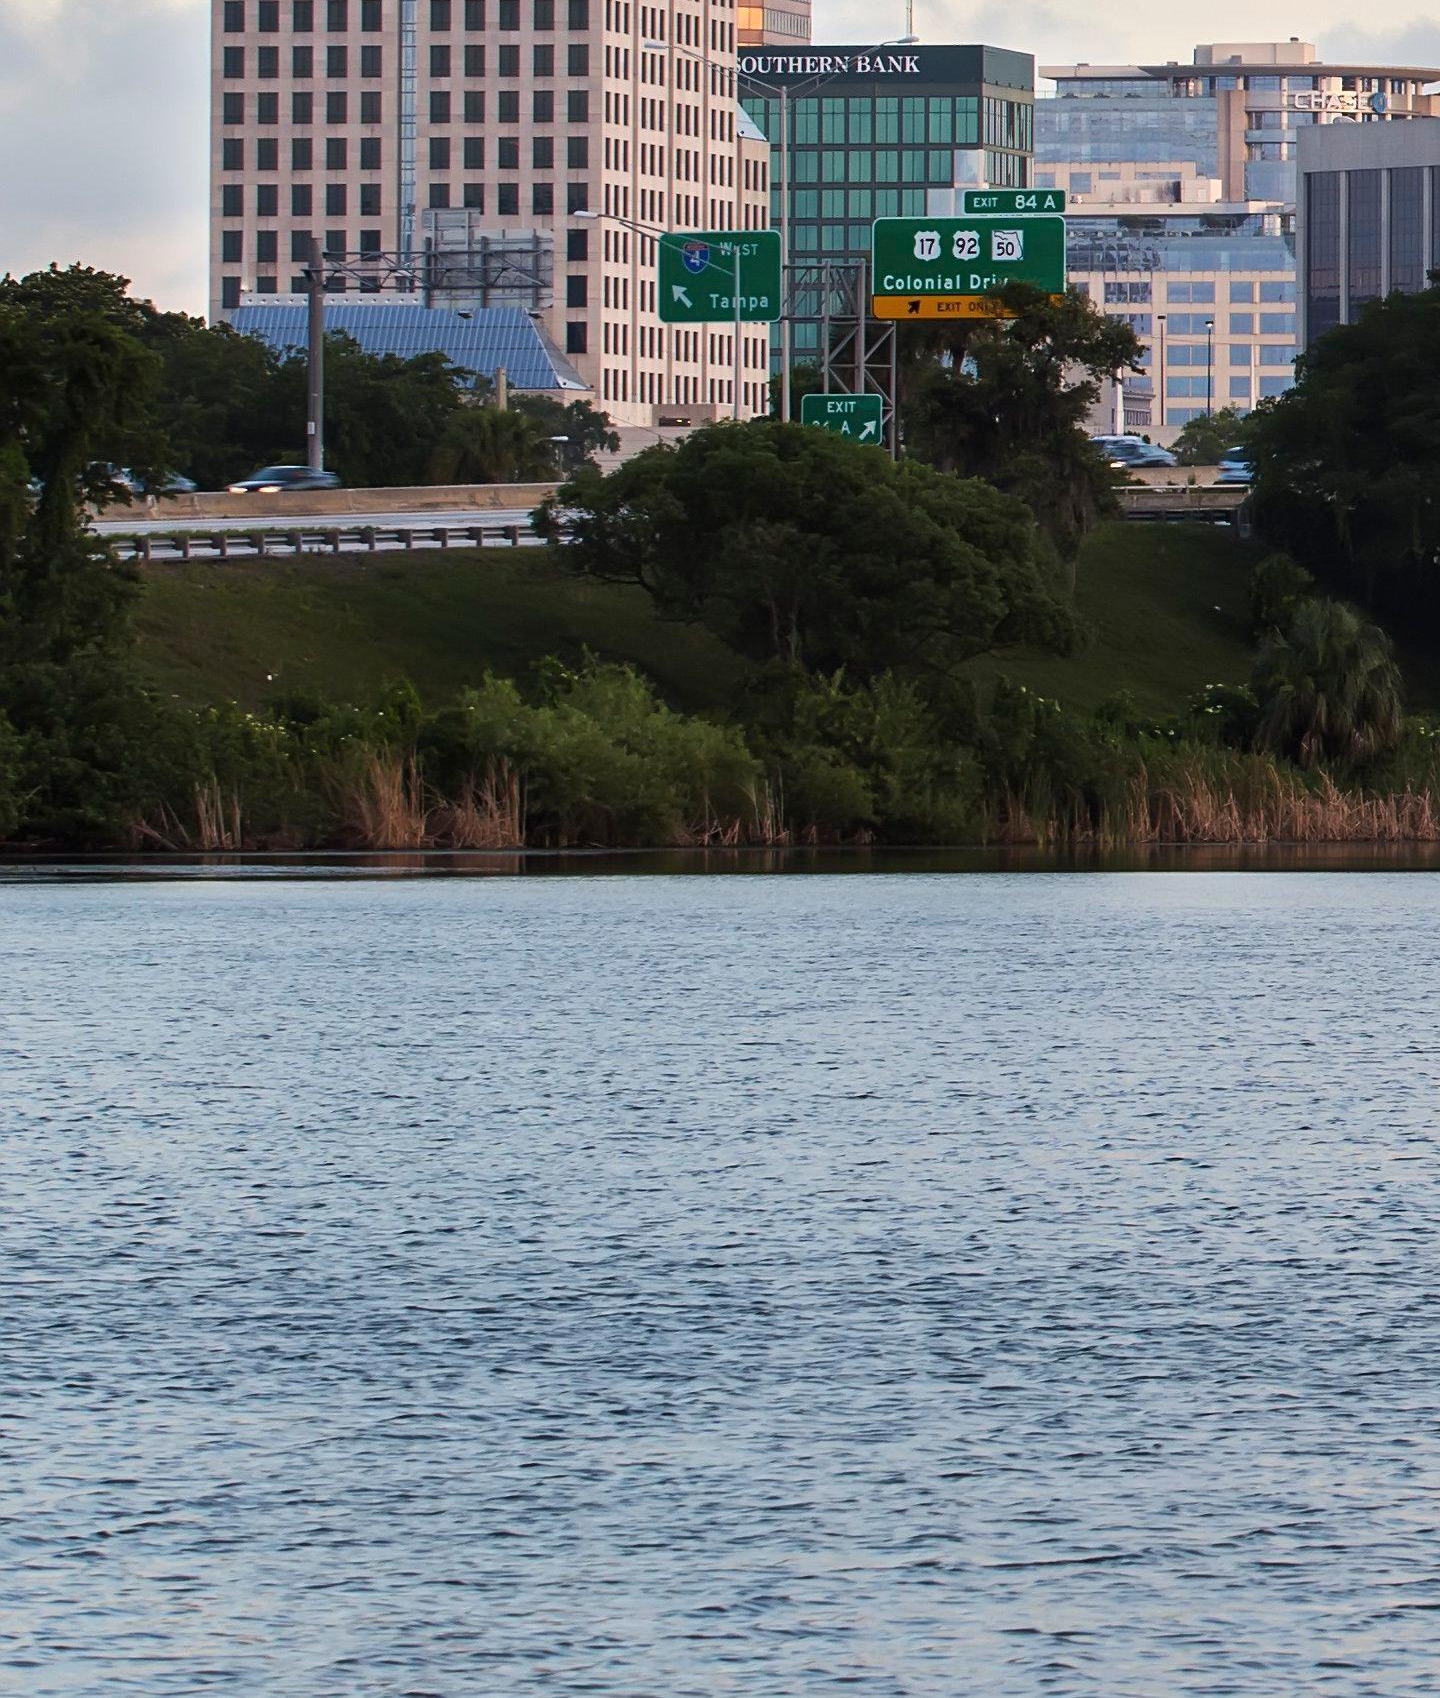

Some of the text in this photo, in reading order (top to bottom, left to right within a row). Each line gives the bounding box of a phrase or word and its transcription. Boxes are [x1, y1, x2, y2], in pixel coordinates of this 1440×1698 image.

[856, 55, 920, 73] BANK
[1294, 92, 1370, 109] CHASE
[973, 195, 1057, 210] EXIT 84 A
[719, 242, 759, 256] WST
[920, 237, 1015, 256] 17 92 50
[689, 250, 700, 267] 4
[883, 274, 961, 291] Colonial
[709, 294, 769, 311] Tampa
[937, 302, 961, 312] EXIT
[827, 401, 856, 413] EXIT
